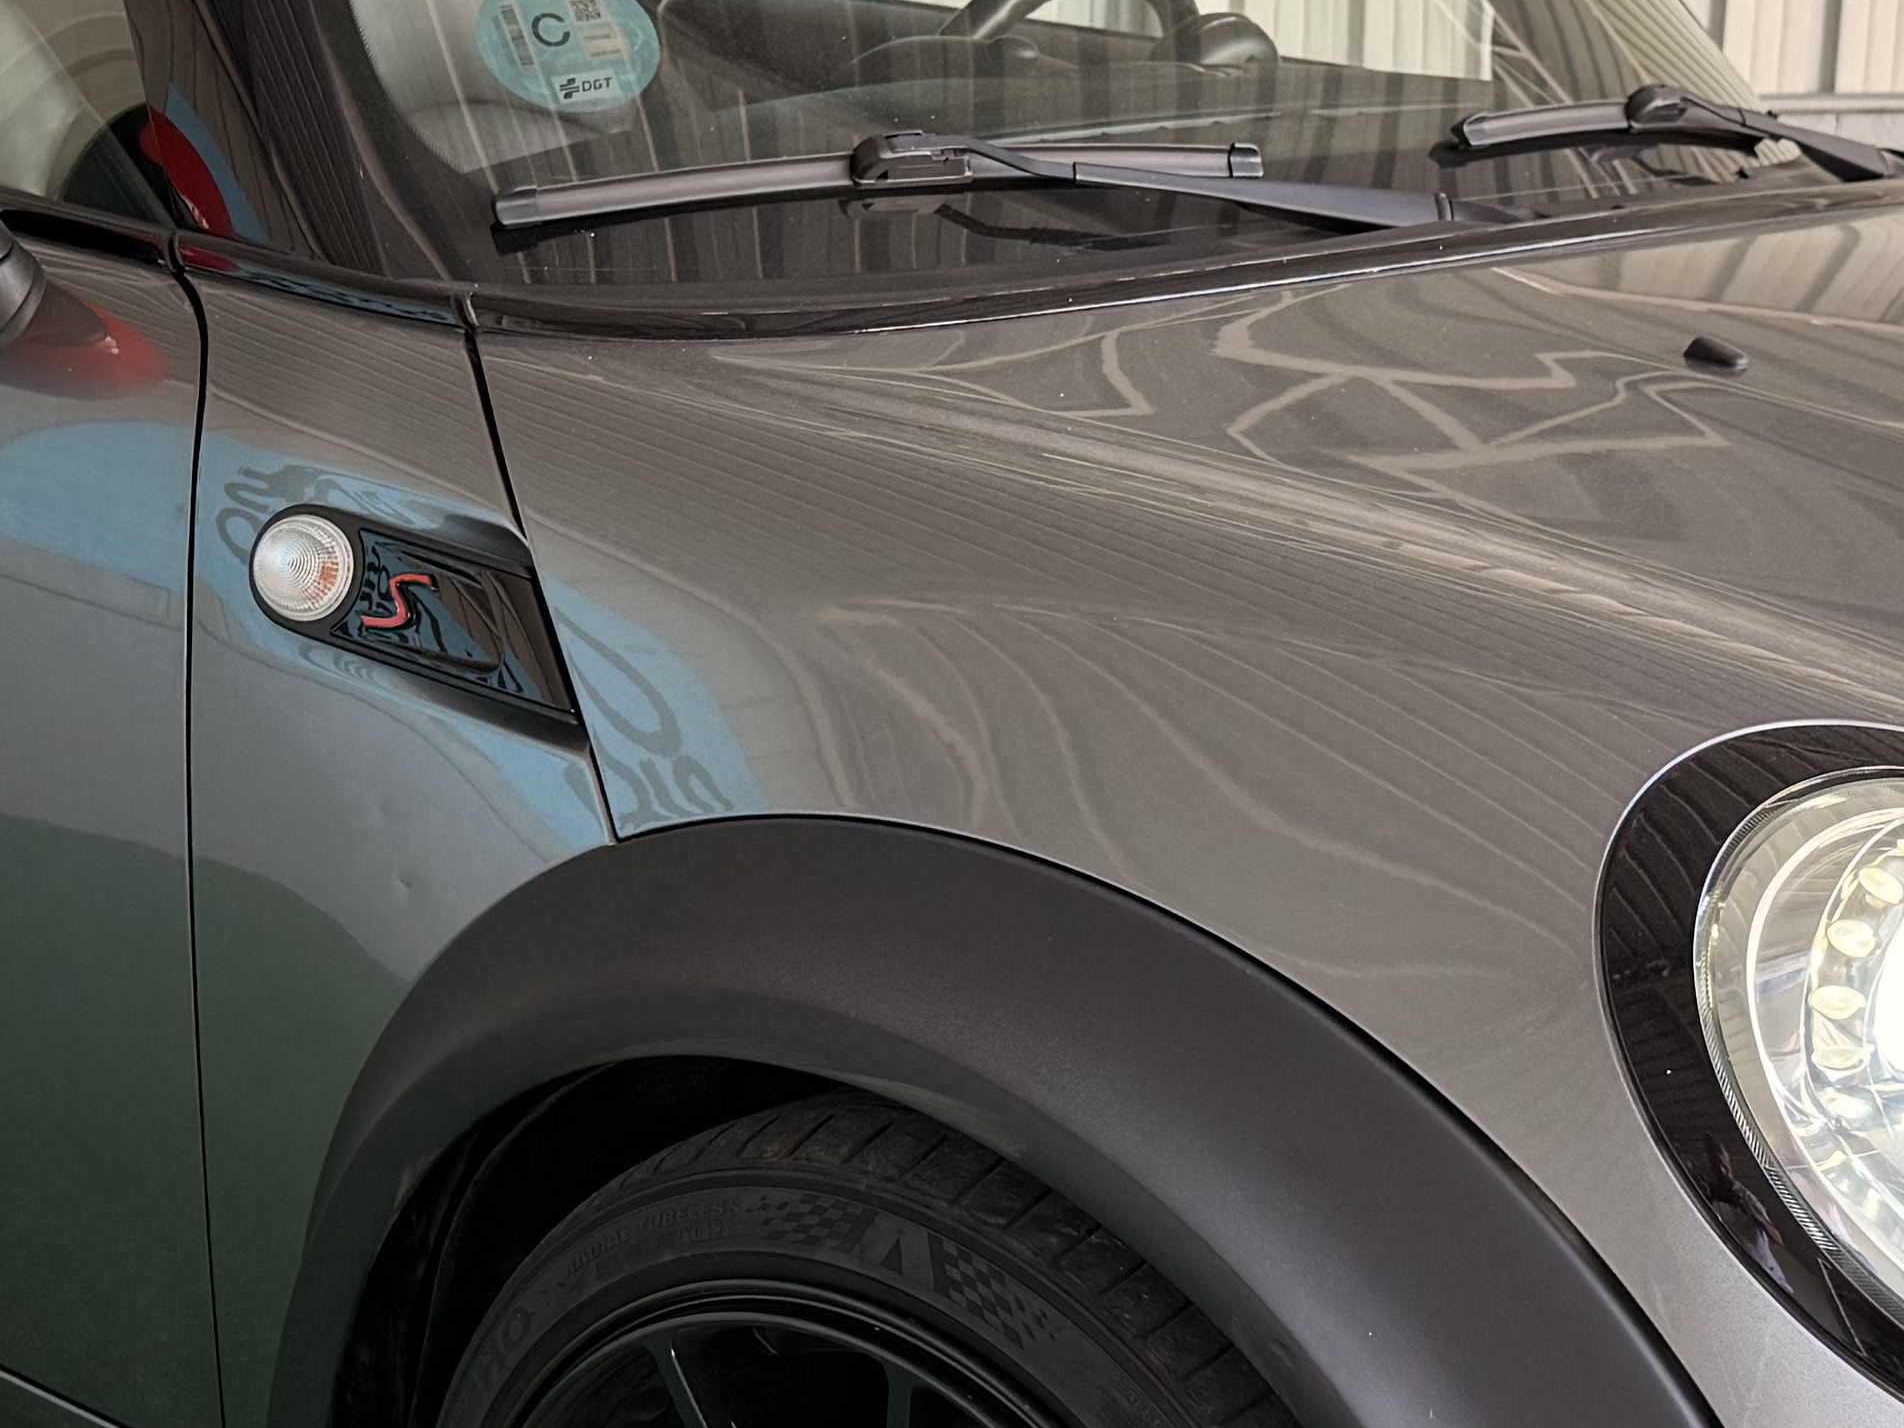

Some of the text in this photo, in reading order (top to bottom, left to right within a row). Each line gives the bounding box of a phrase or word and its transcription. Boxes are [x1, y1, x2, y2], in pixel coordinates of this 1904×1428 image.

[531, 12, 571, 47] C
[581, 76, 613, 92] DGT
[360, 573, 439, 628] S
